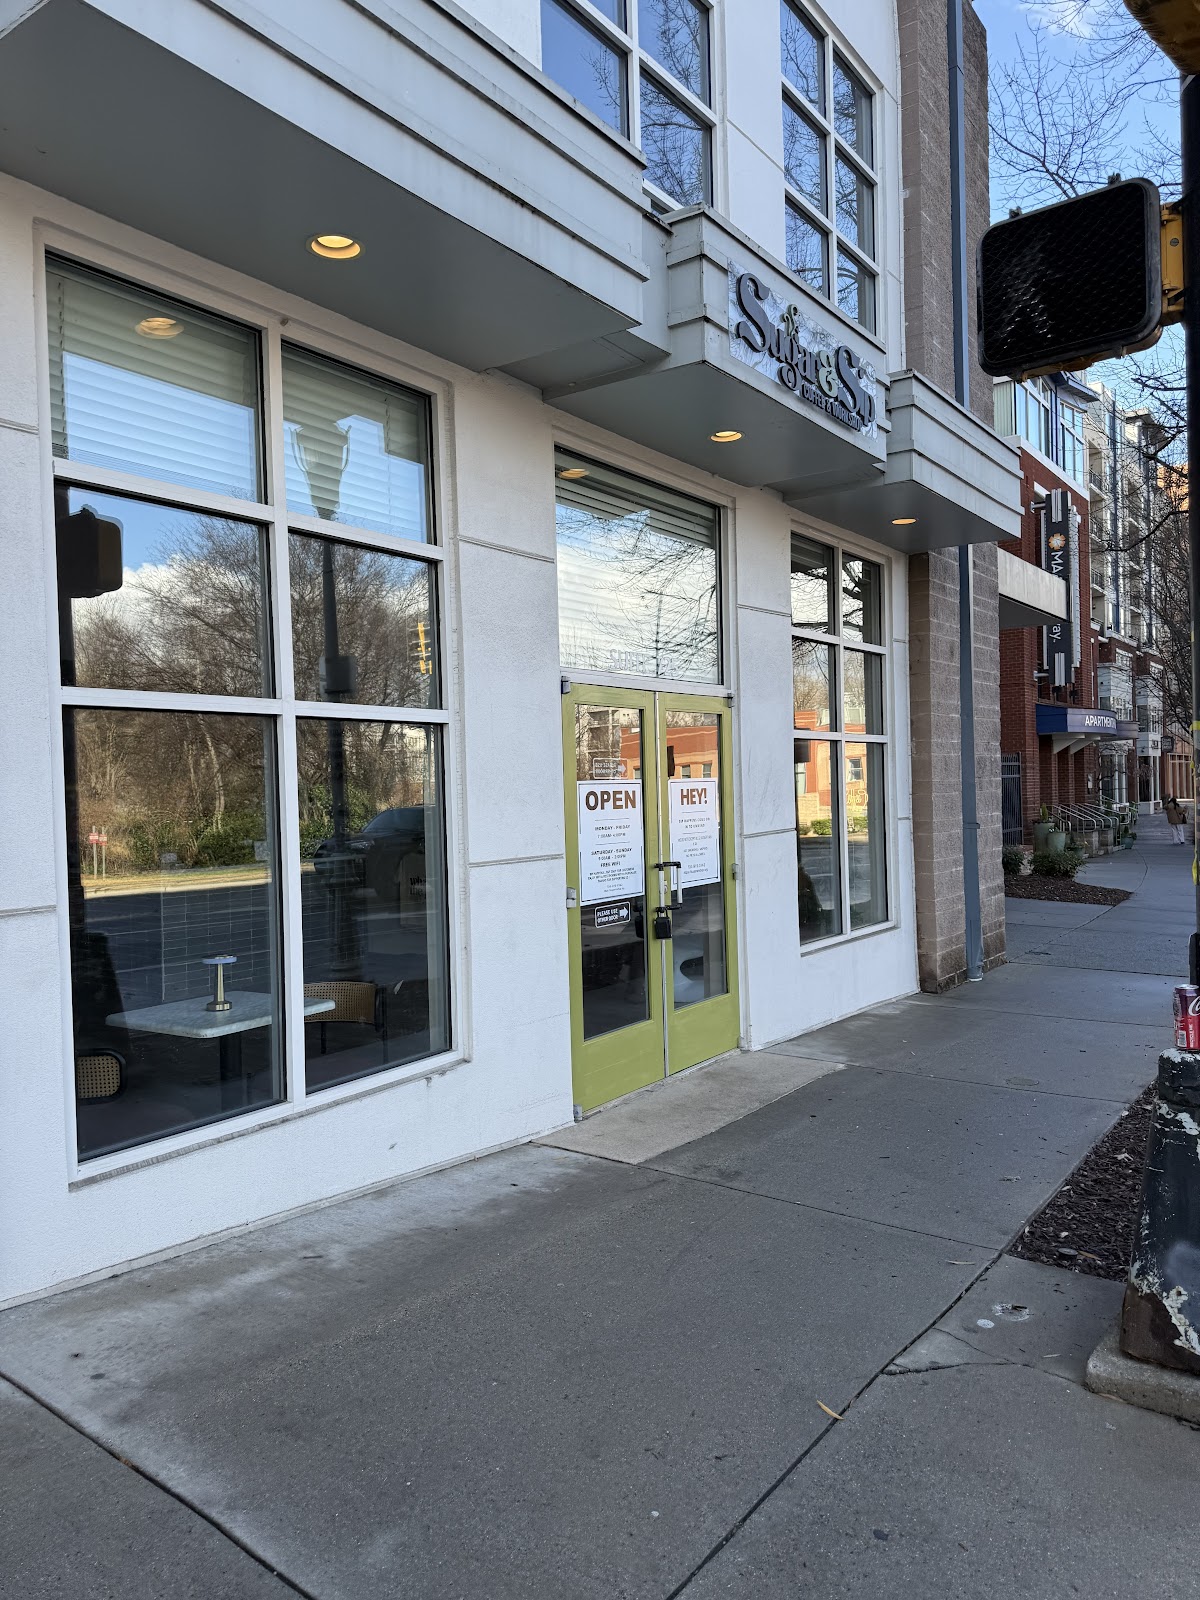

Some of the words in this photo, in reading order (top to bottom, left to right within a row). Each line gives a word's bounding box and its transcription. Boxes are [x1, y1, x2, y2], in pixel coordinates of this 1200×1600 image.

[734, 273, 821, 391] Sugar
[817, 349, 838, 398] &
[836, 345, 875, 426] Sip
[802, 382, 826, 409] COFFEE
[825, 399, 832, 414] &
[831, 402, 864, 432] WORKSHOP
[1050, 551, 1063, 580] MA
[585, 790, 637, 811] OPEN
[680, 788, 708, 806] HEY!
[597, 909, 611, 917] PLEASE
